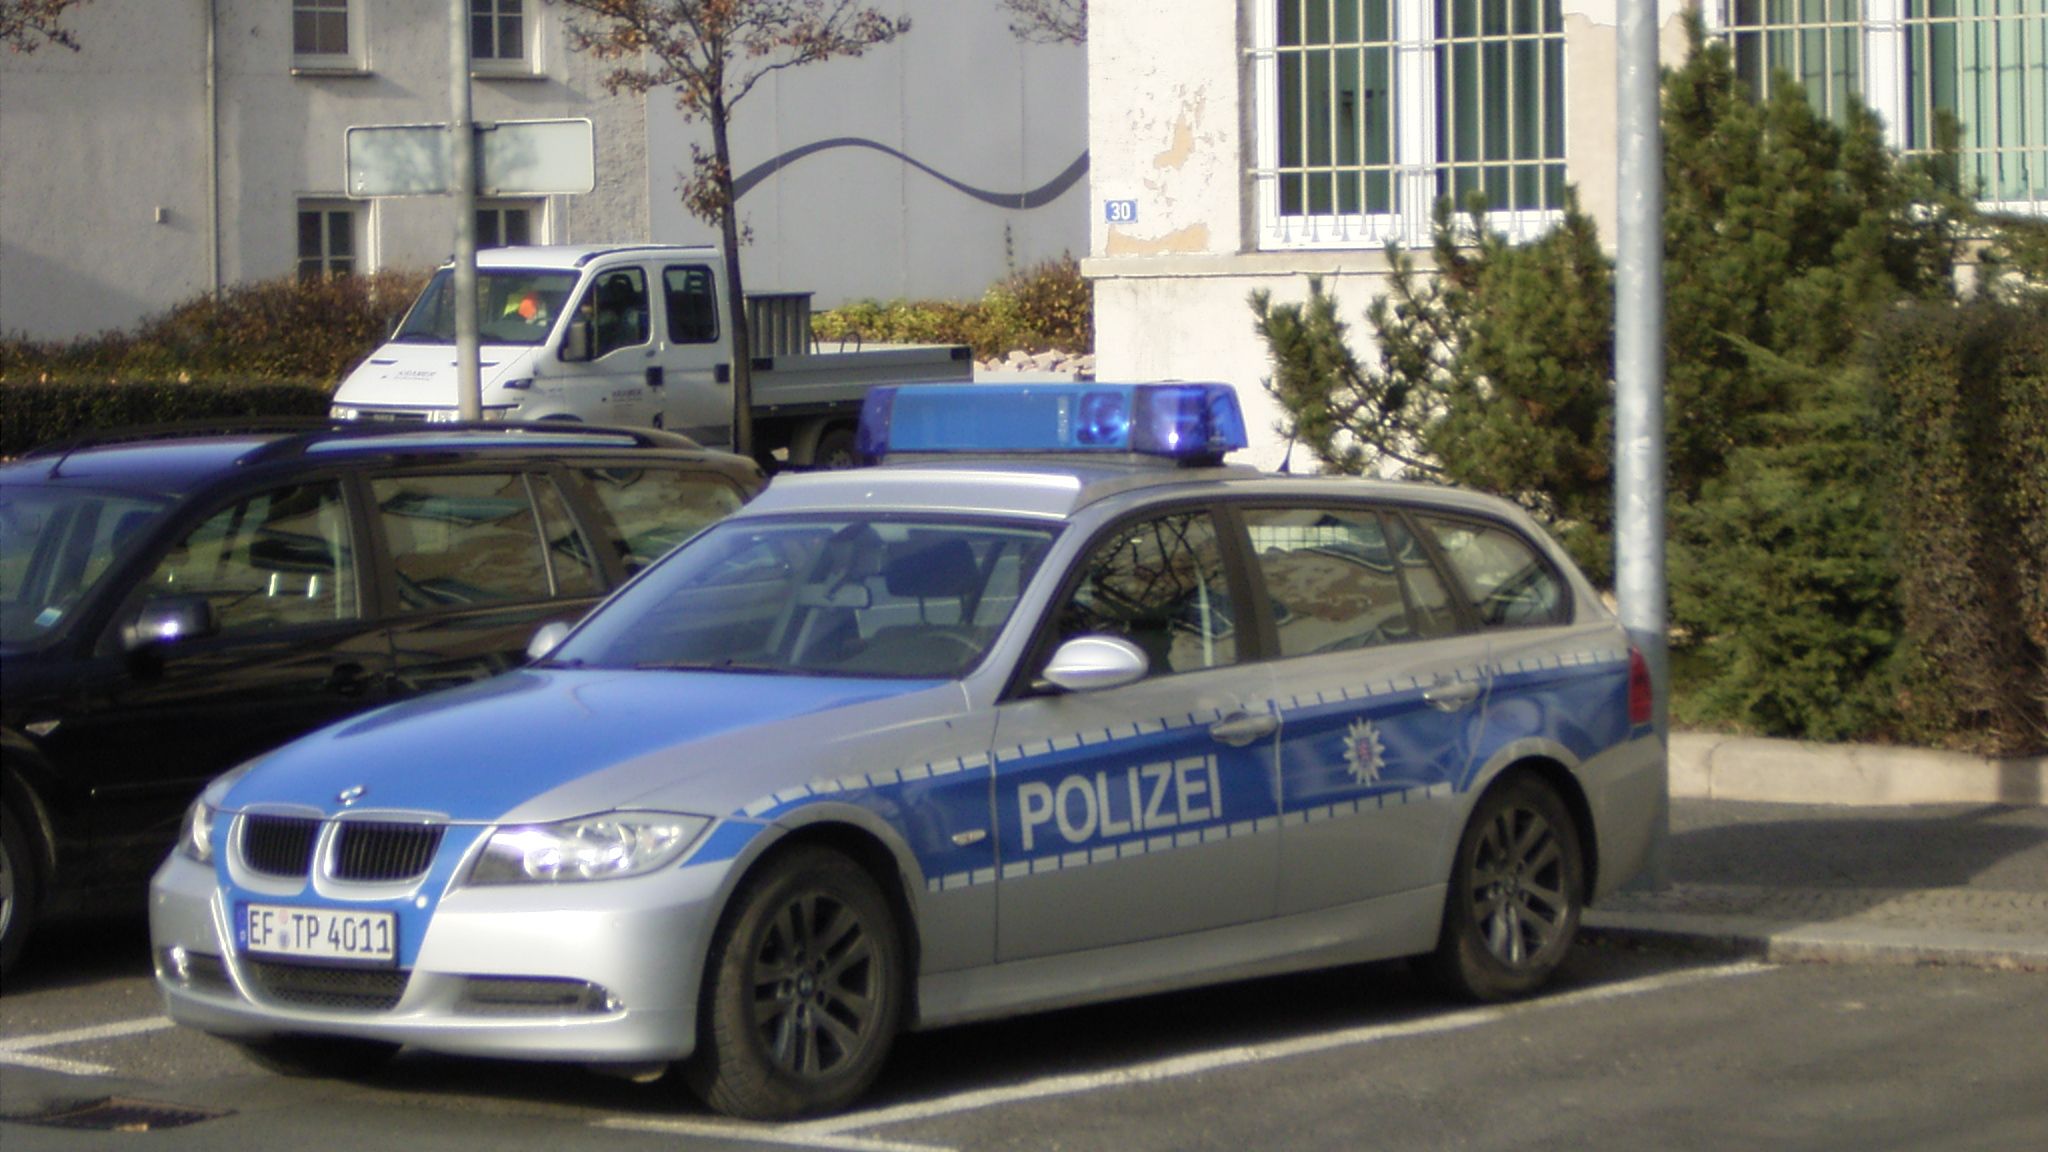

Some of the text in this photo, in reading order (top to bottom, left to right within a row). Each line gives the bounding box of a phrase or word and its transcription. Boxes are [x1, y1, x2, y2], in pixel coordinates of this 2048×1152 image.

[1111, 202, 1130, 220] 30
[1018, 754, 1222, 851] POLIZEI
[250, 911, 391, 953] EF TP 4011
